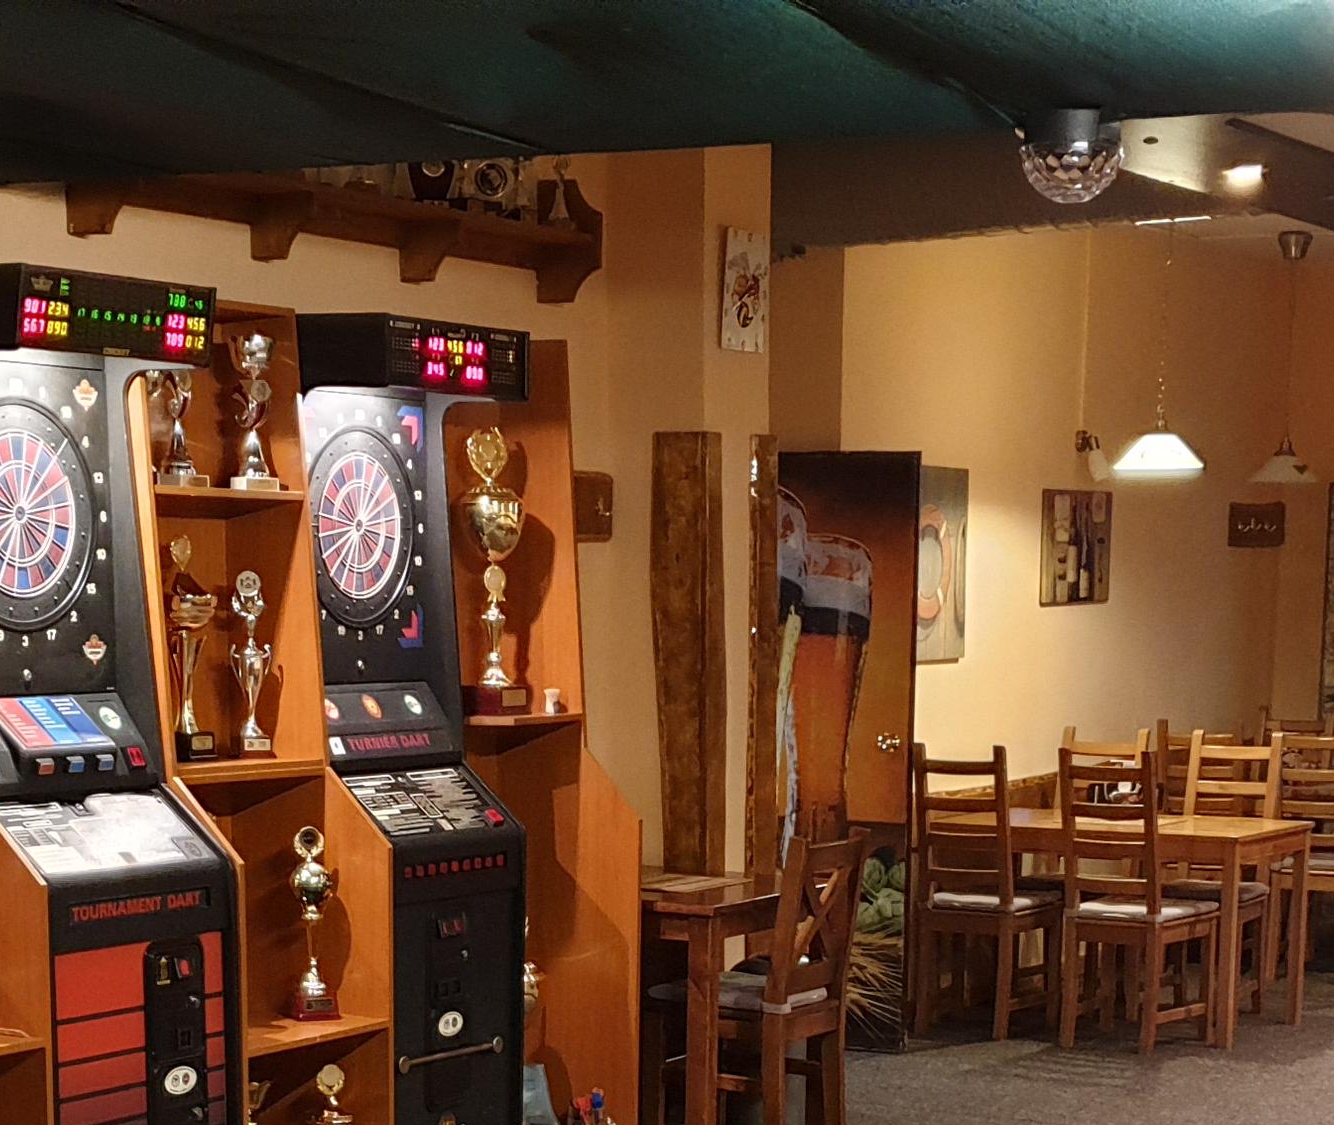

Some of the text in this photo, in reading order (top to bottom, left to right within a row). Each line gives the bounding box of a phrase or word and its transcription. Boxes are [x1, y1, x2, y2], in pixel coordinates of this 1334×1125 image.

[48, 301, 69, 317] 234
[23, 318, 45, 333] 567
[168, 313, 185, 330] 123
[187, 317, 206, 331] 456
[70, 611, 78, 622] 2
[347, 735, 399, 751] TURNIER
[400, 733, 430, 747] DART
[72, 891, 201, 922] TOURNAMENT DART
